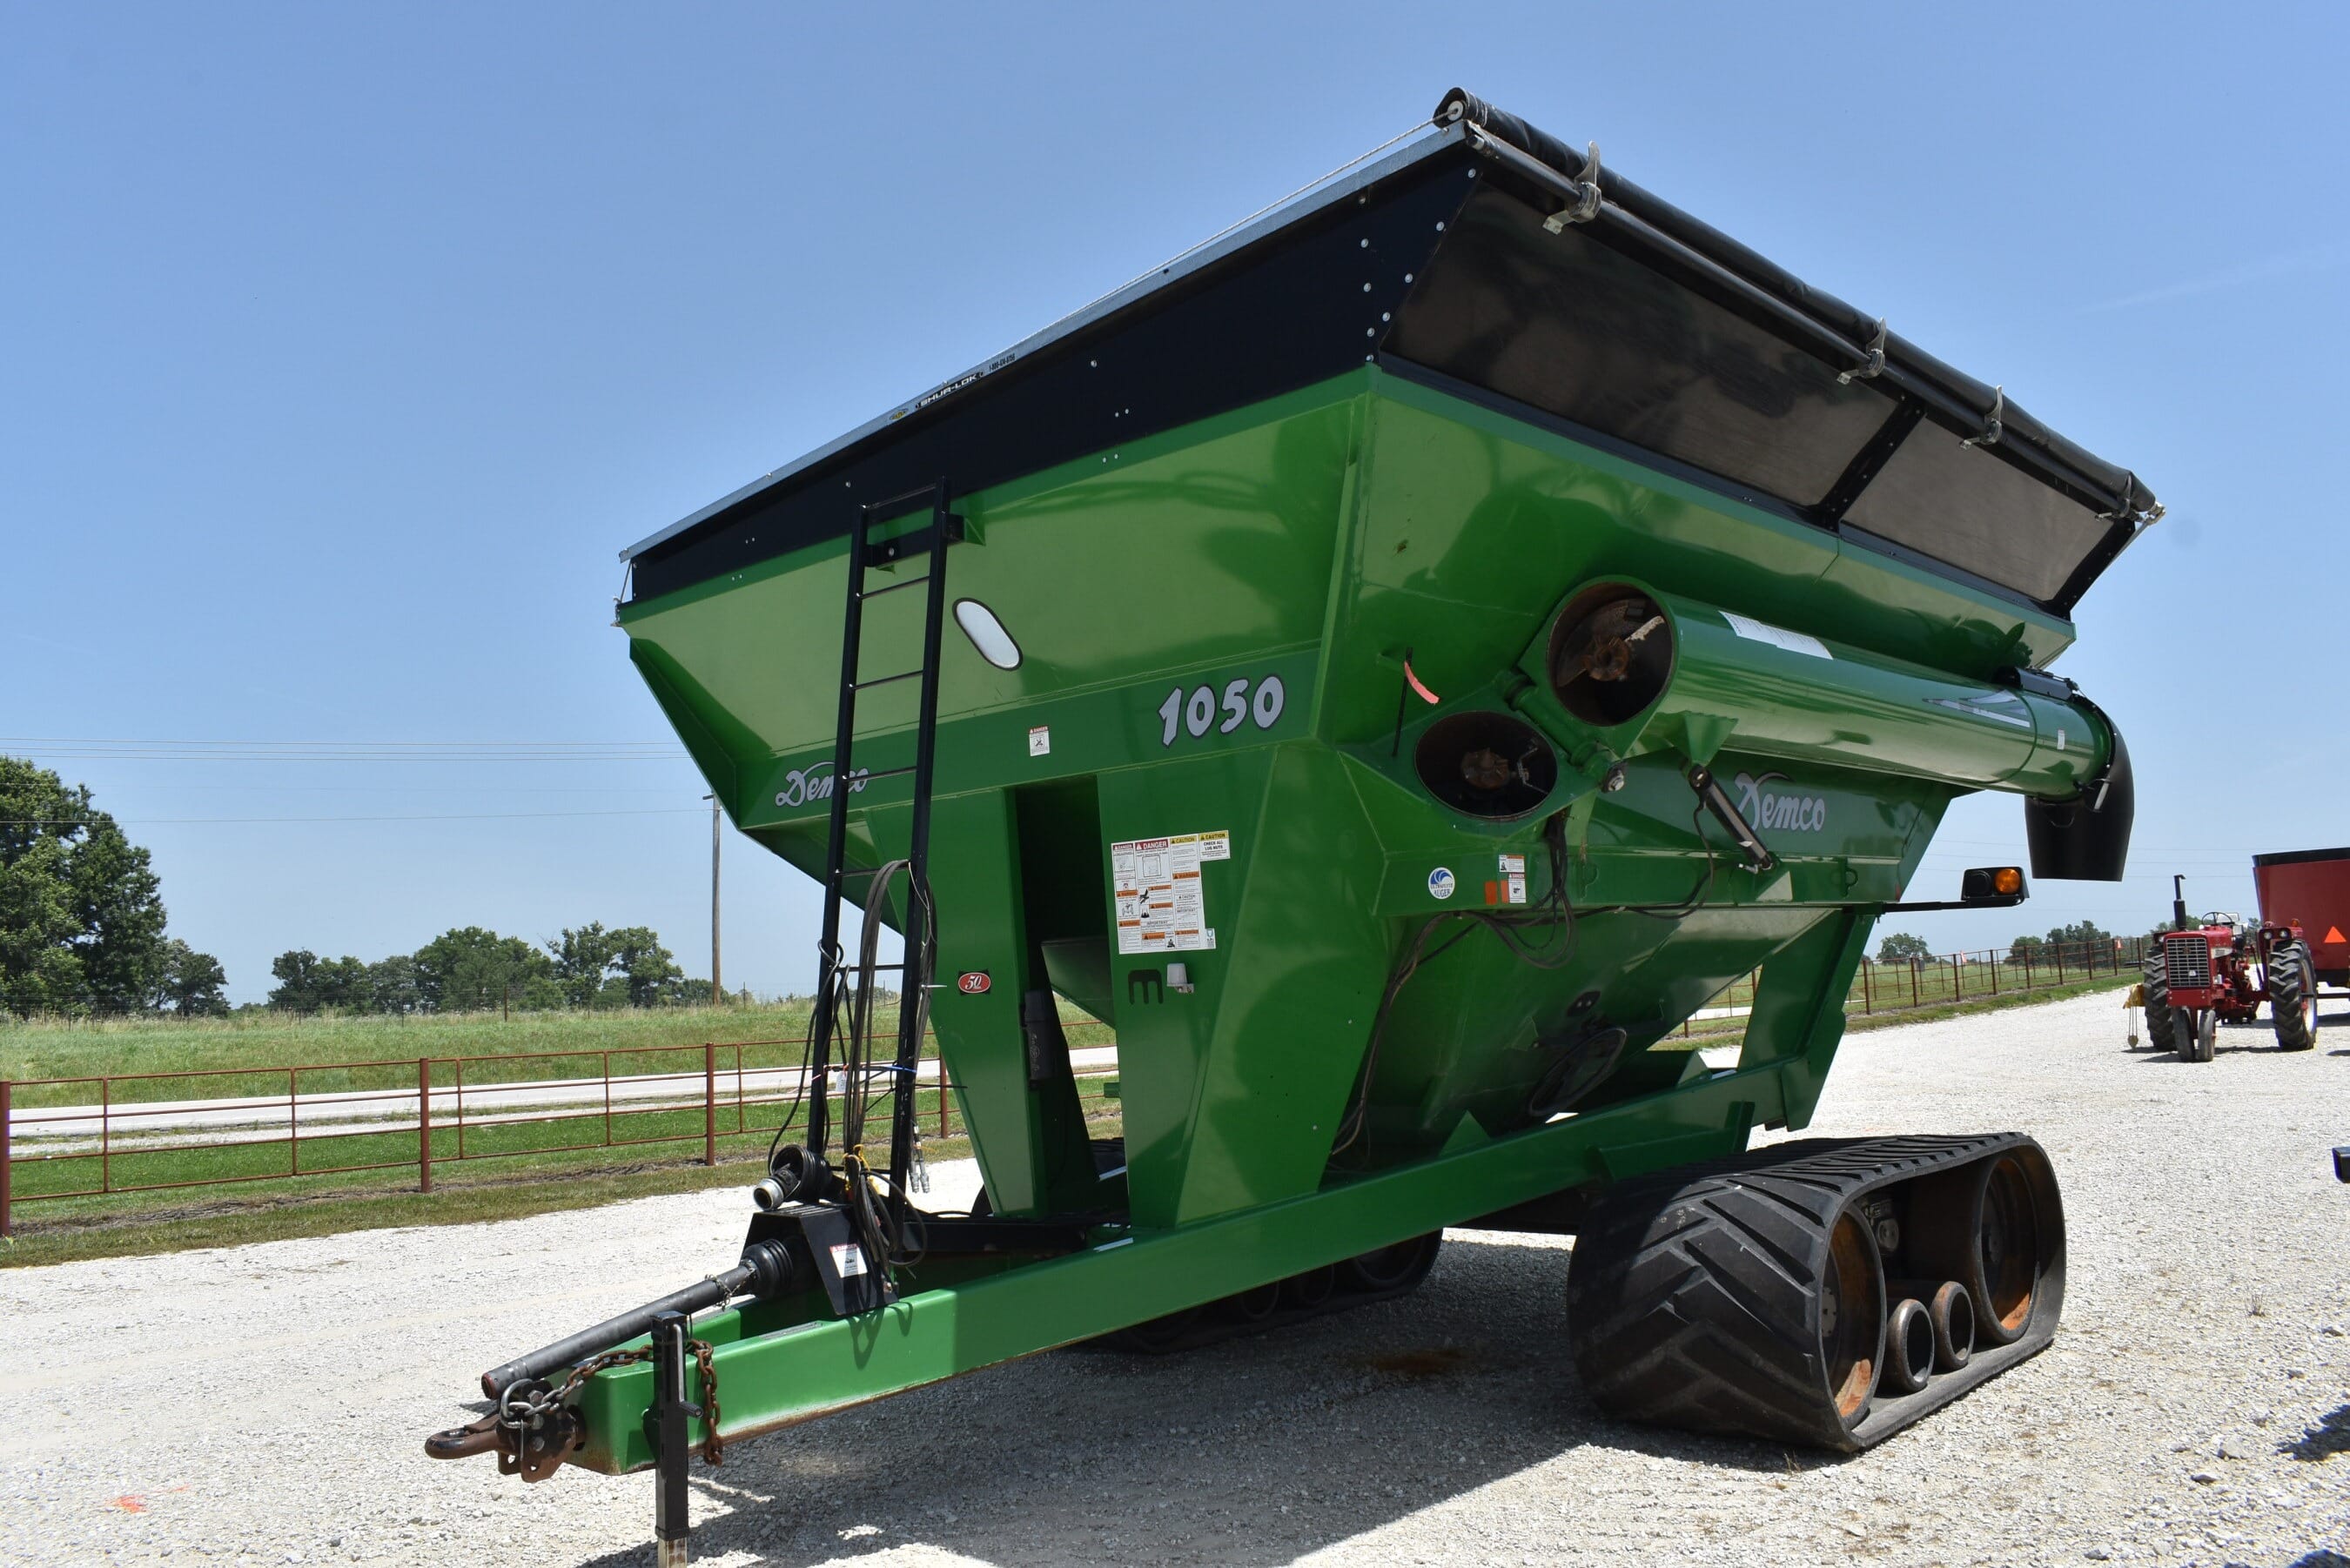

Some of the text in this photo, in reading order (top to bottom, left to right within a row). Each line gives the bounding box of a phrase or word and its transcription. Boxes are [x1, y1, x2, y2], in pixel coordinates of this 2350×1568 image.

[920, 373, 977, 407] SHUR-LOK
[1158, 673, 1285, 748] 1050
[1735, 771, 1826, 832] Demco
[1143, 841, 1167, 850] DANGER
[1434, 888, 1451, 897] AUGER
[965, 975, 982, 989] 50
